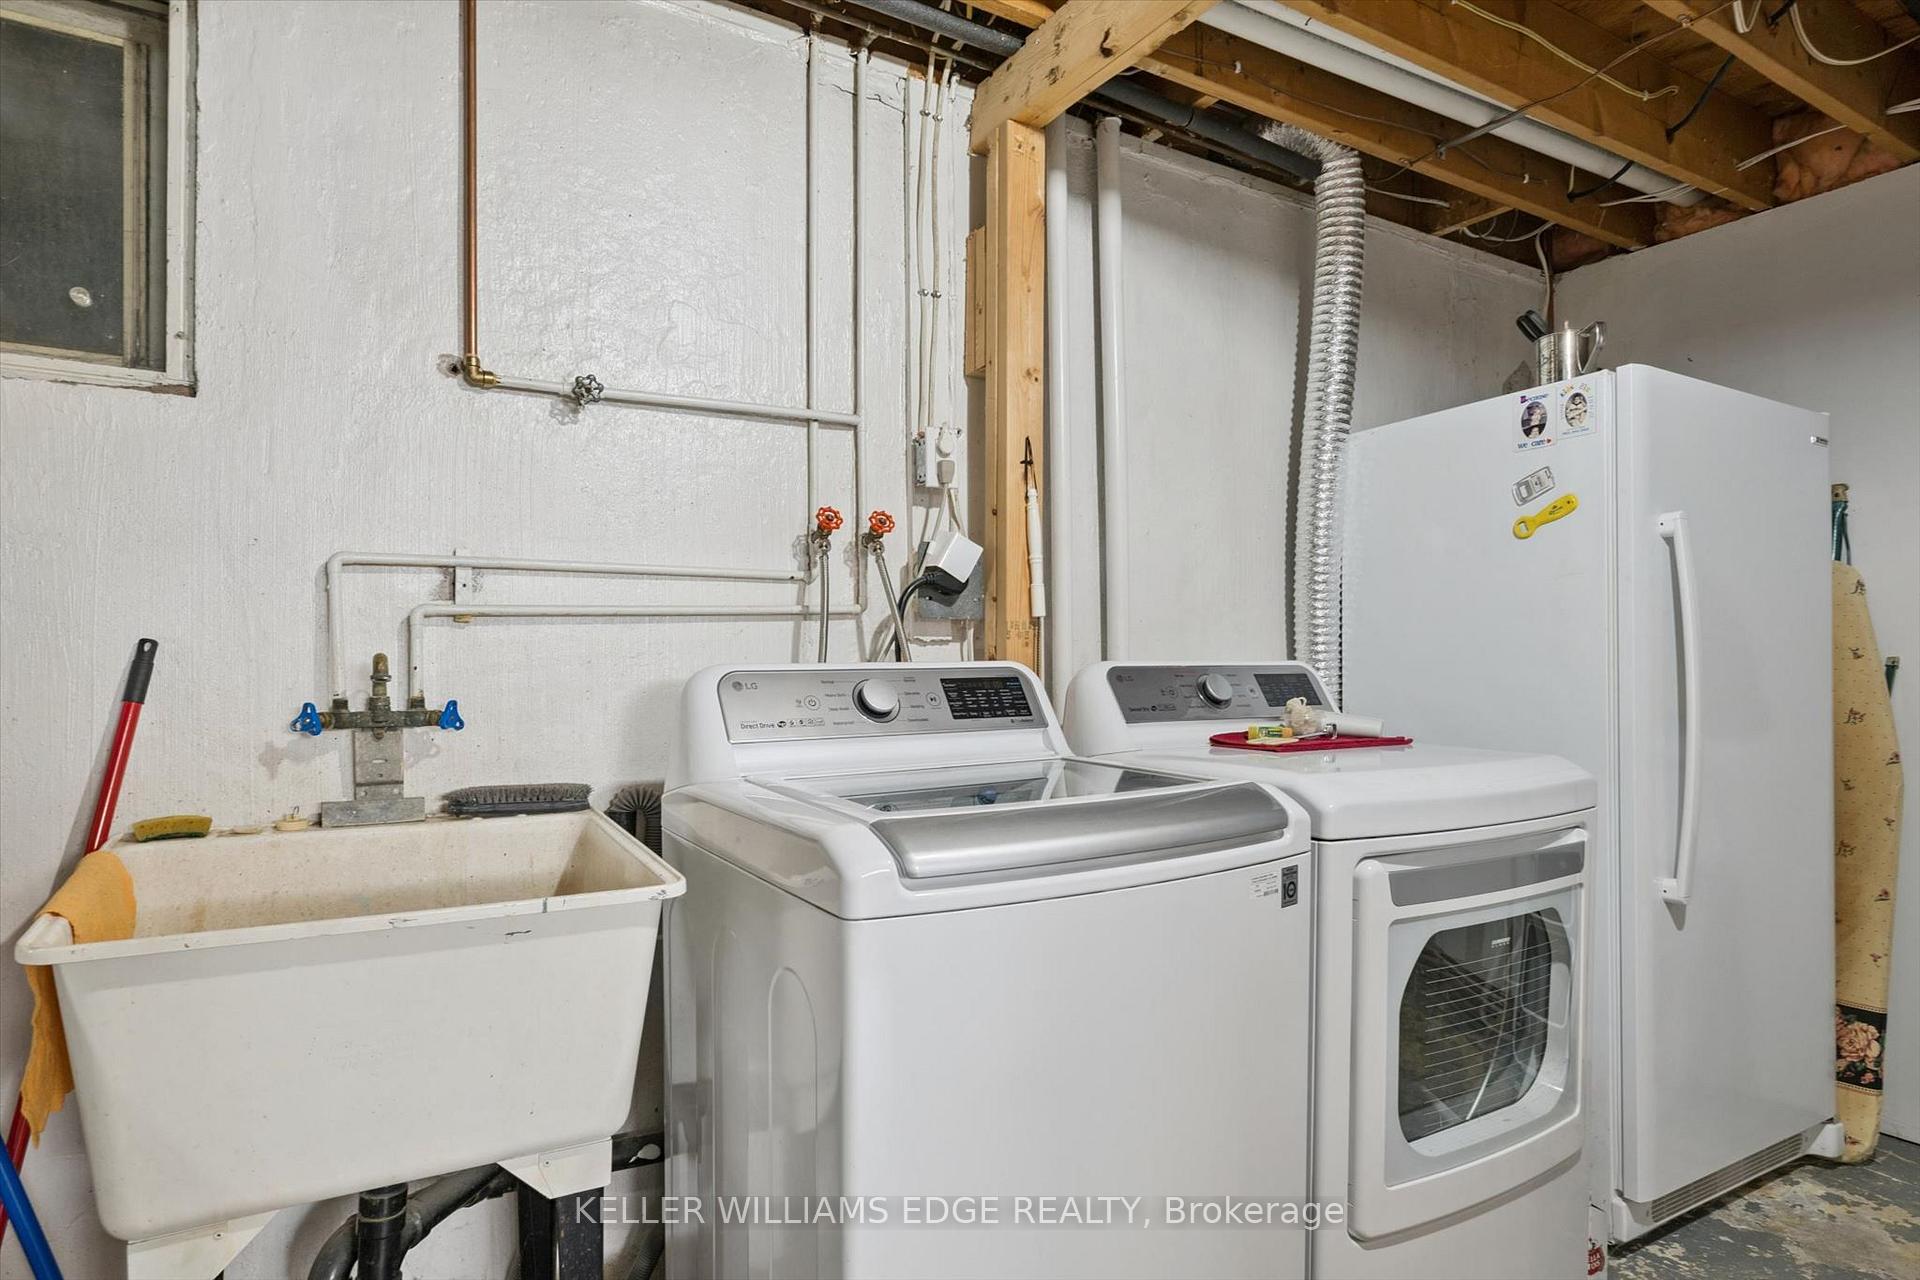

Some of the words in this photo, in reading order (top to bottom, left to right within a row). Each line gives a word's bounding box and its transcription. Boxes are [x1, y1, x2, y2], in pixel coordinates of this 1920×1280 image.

[744, 682, 758, 690] LG
[740, 721, 759, 730] Direct
[759, 719, 775, 729] Drive
